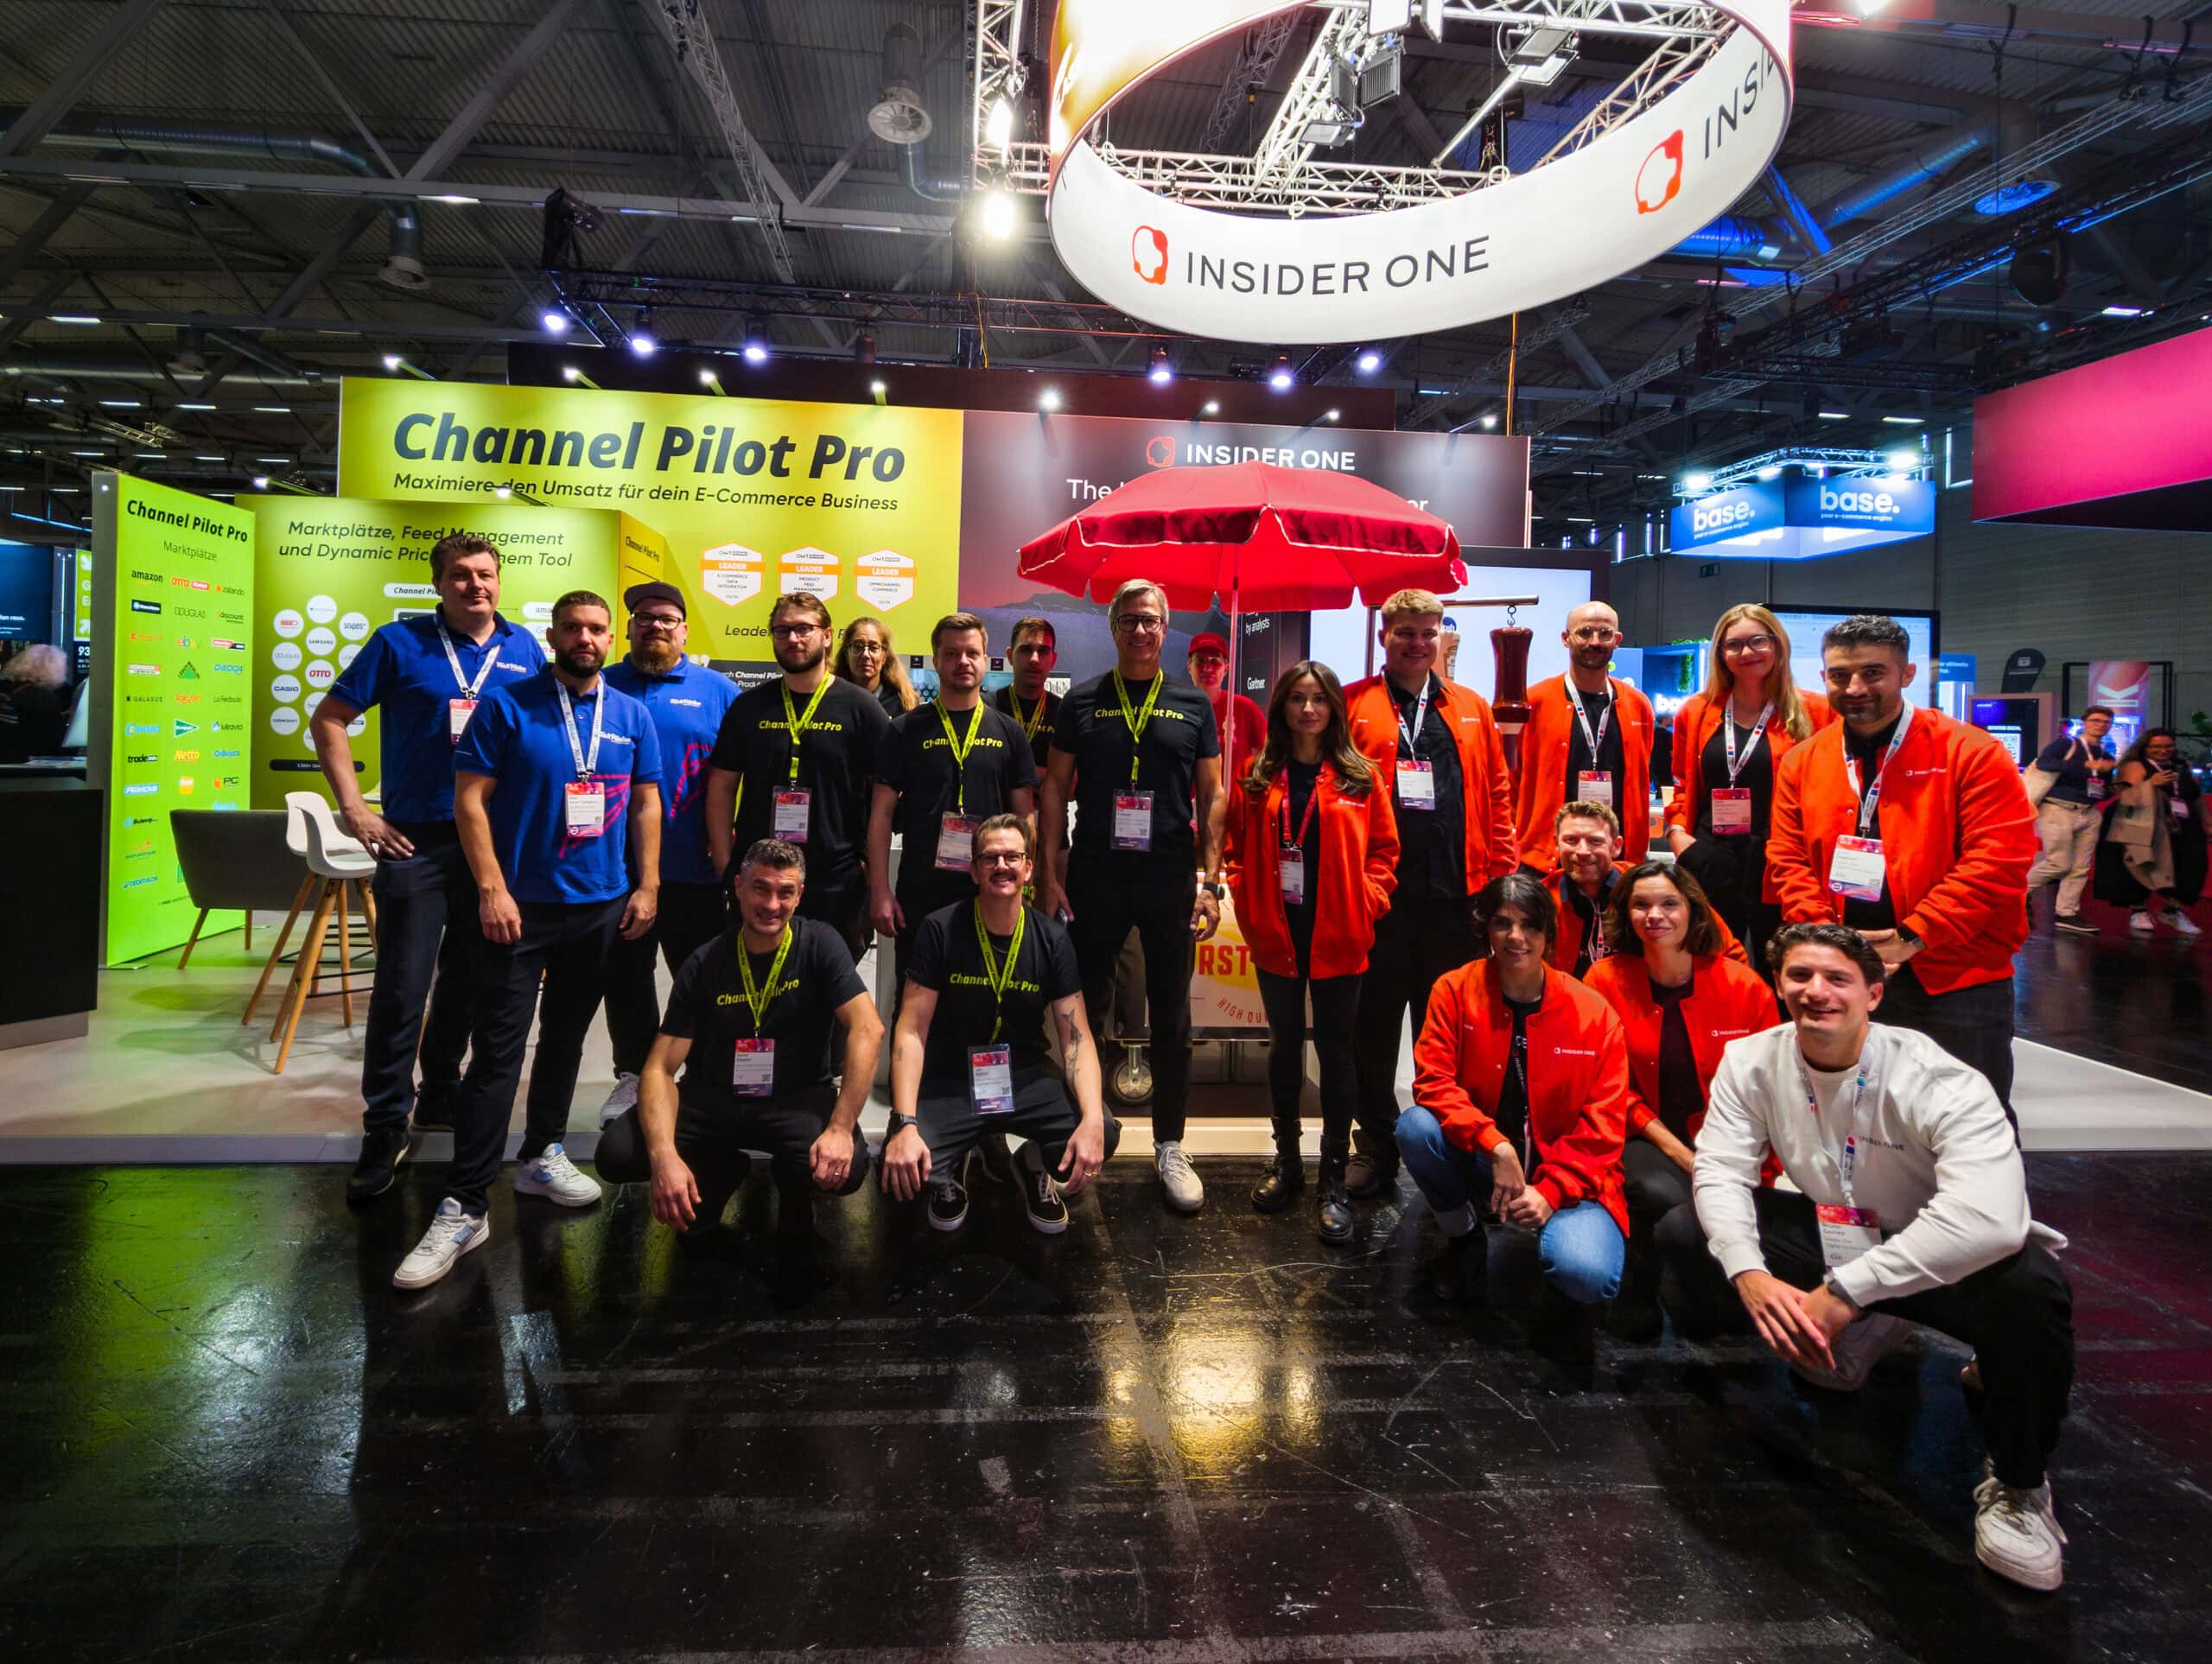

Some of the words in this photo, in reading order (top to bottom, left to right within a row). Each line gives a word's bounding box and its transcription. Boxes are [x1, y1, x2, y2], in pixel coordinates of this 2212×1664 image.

[1186, 251, 1369, 296] INSIDER
[1386, 235, 1491, 289] ONE
[393, 411, 645, 470] Channel
[656, 424, 797, 478] Pilot
[808, 434, 906, 483] Pro
[1186, 444, 1295, 467] INSIDER
[1301, 449, 1356, 471] ONE
[394, 473, 494, 492] Maximiere
[505, 479, 537, 494] den
[543, 480, 613, 499] Umsatz
[619, 482, 644, 500] für
[649, 485, 690, 502] dein
[695, 487, 817, 508] E-Commerce
[821, 492, 899, 511] Business
[1066, 479, 1113, 500] The
[1820, 485, 1901, 514] base.
[127, 499, 189, 528] Channel
[193, 516, 225, 537] Pilot
[226, 525, 248, 543] Pro
[1694, 500, 1756, 532] base.
[289, 520, 395, 540] Marktplätze,
[402, 525, 444, 541] Feed
[163, 540, 218, 562] Marktplätze
[279, 544, 312, 557] und
[318, 544, 393, 562] Dynamic
[539, 552, 573, 568] Tool
[719, 562, 747, 570] LEADER
[796, 565, 823, 574] LEADER
[872, 568, 899, 576] LEADER
[131, 569, 163, 583] amazon
[725, 625, 768, 637] Leade
[309, 670, 332, 678] OTTO
[1247, 677, 1265, 690] Gartner
[1166, 709, 1184, 720] Pro
[823, 721, 842, 731] Pro
[986, 738, 1003, 747] Pro
[175, 750, 200, 761] Netto
[1021, 981, 1039, 993] Pro
[1217, 997, 1244, 1020] HIGH
